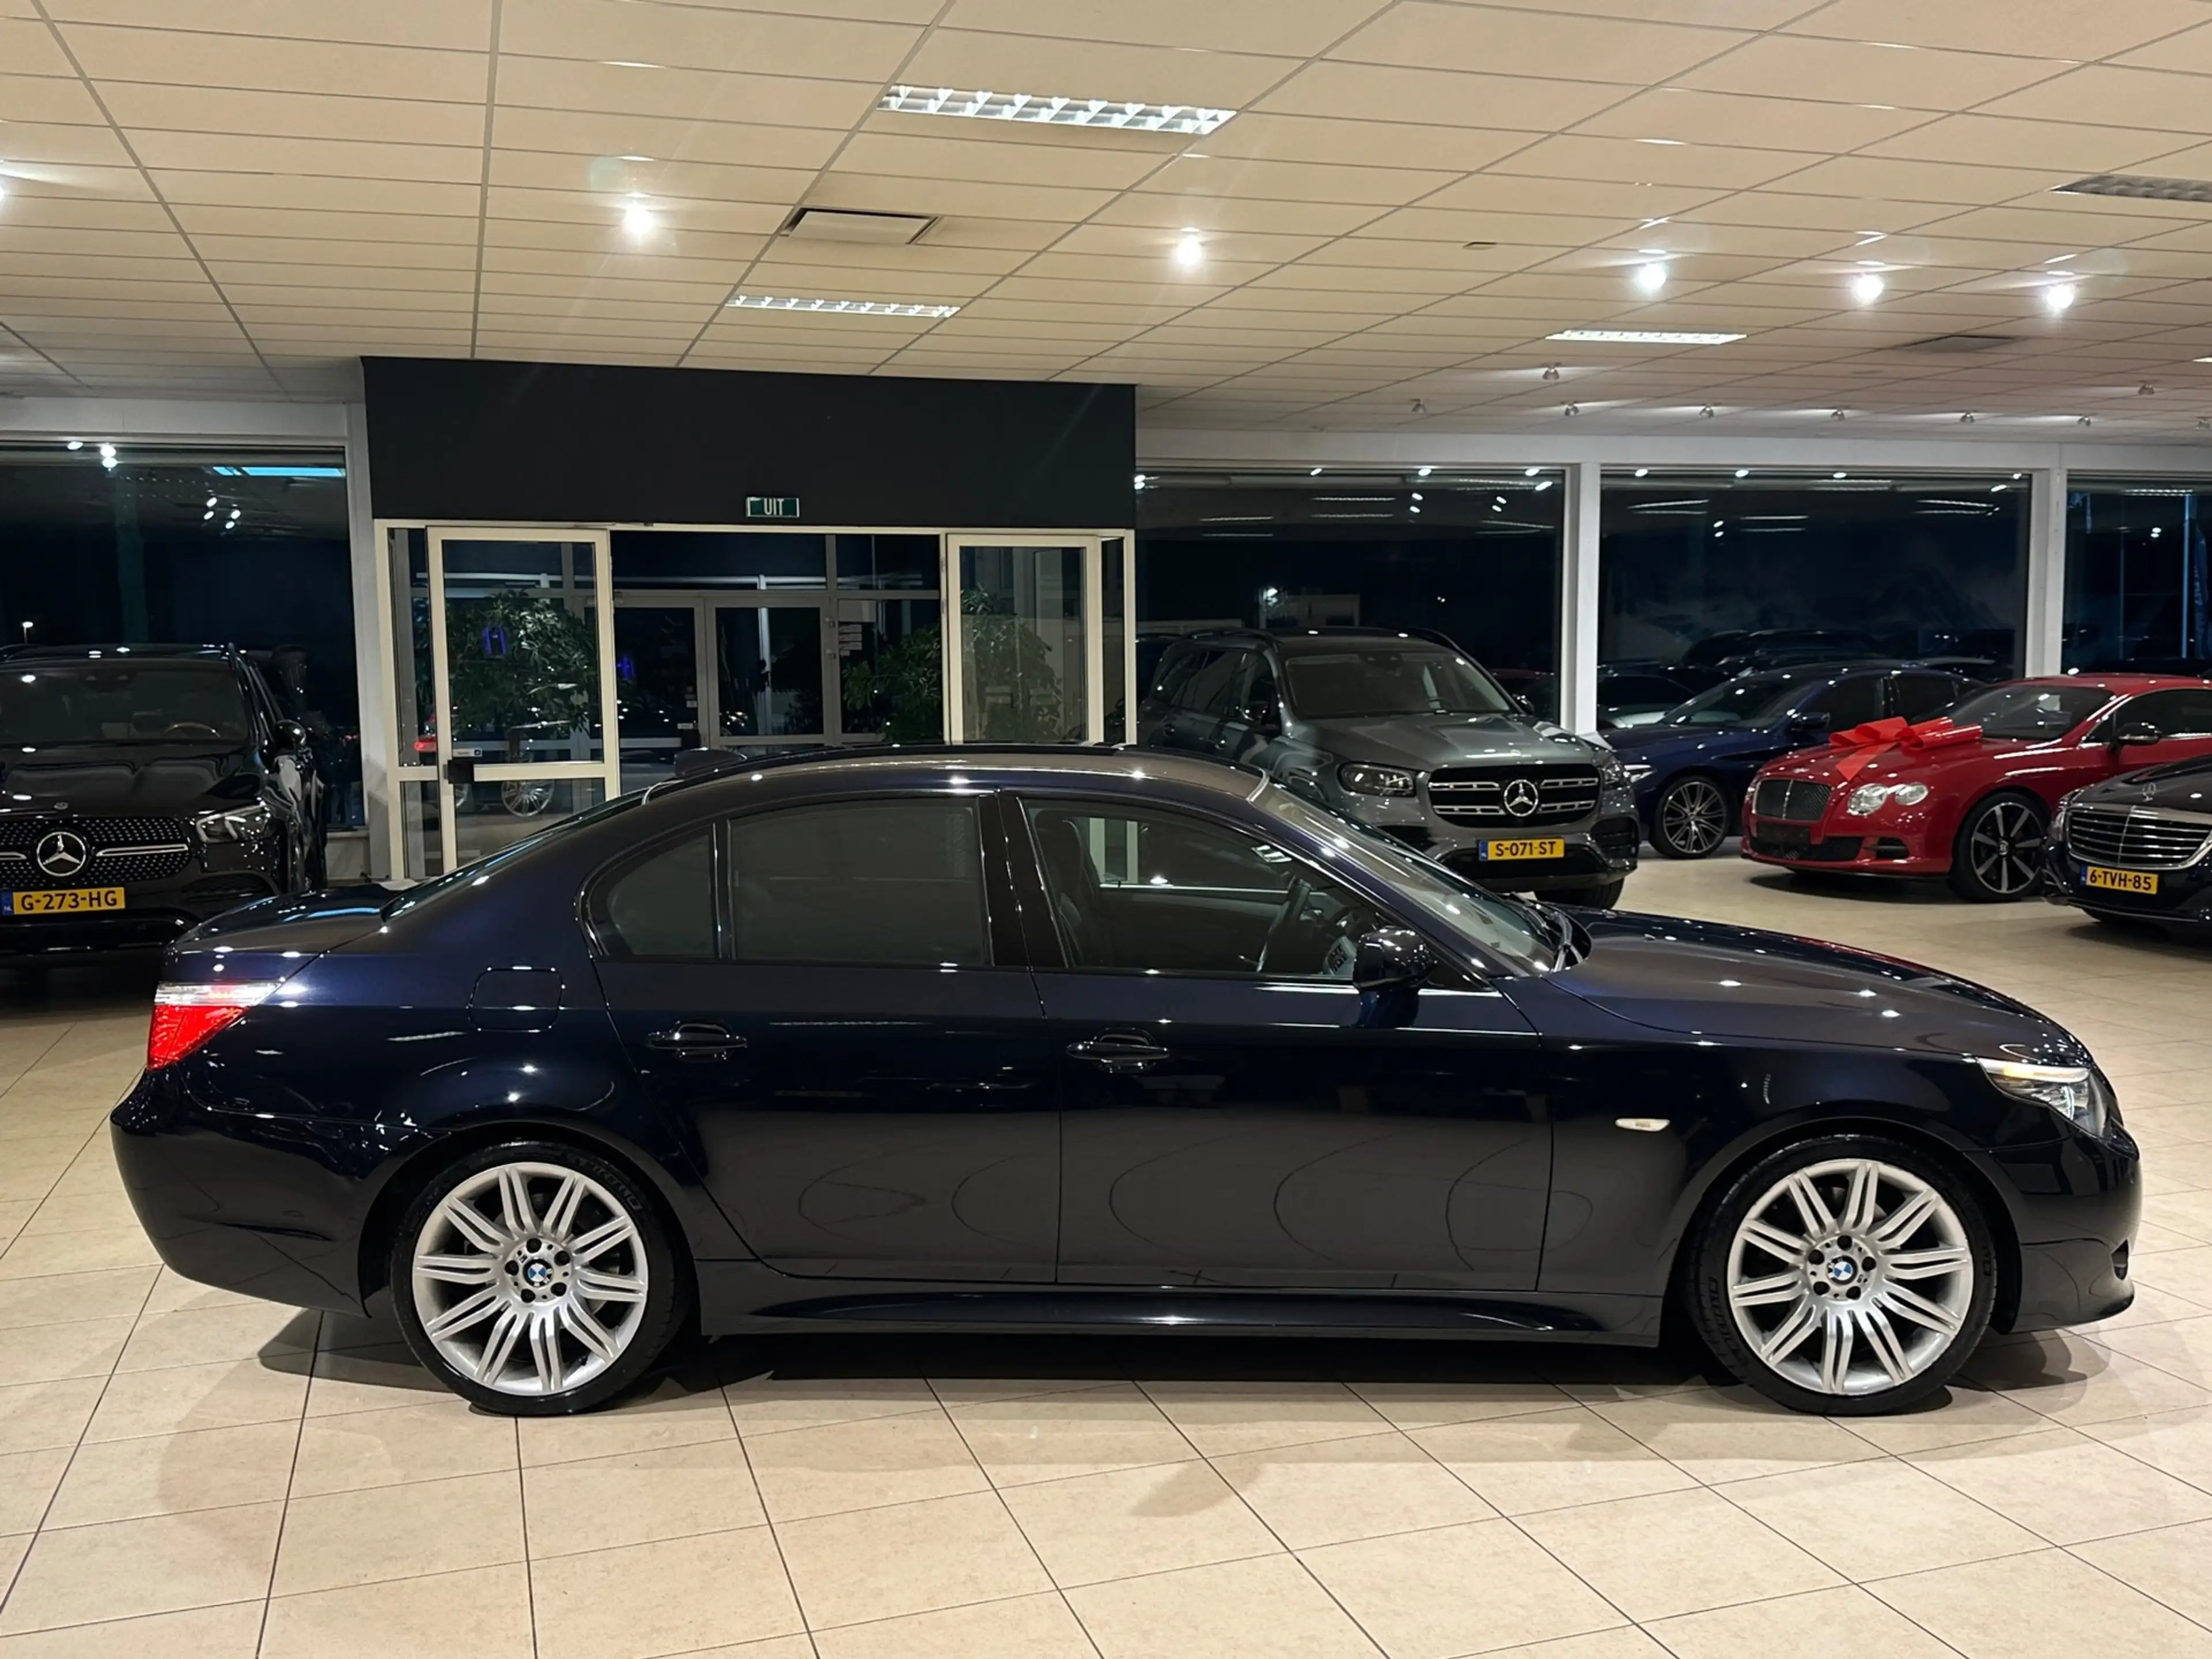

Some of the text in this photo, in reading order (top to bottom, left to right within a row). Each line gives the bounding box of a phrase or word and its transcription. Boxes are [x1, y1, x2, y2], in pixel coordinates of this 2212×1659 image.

[764, 498, 784, 515] UIT
[1495, 841, 1556, 857] S-071-ST
[2090, 869, 2152, 891] 6-TVH-85
[21, 890, 118, 911] G-273-HG
